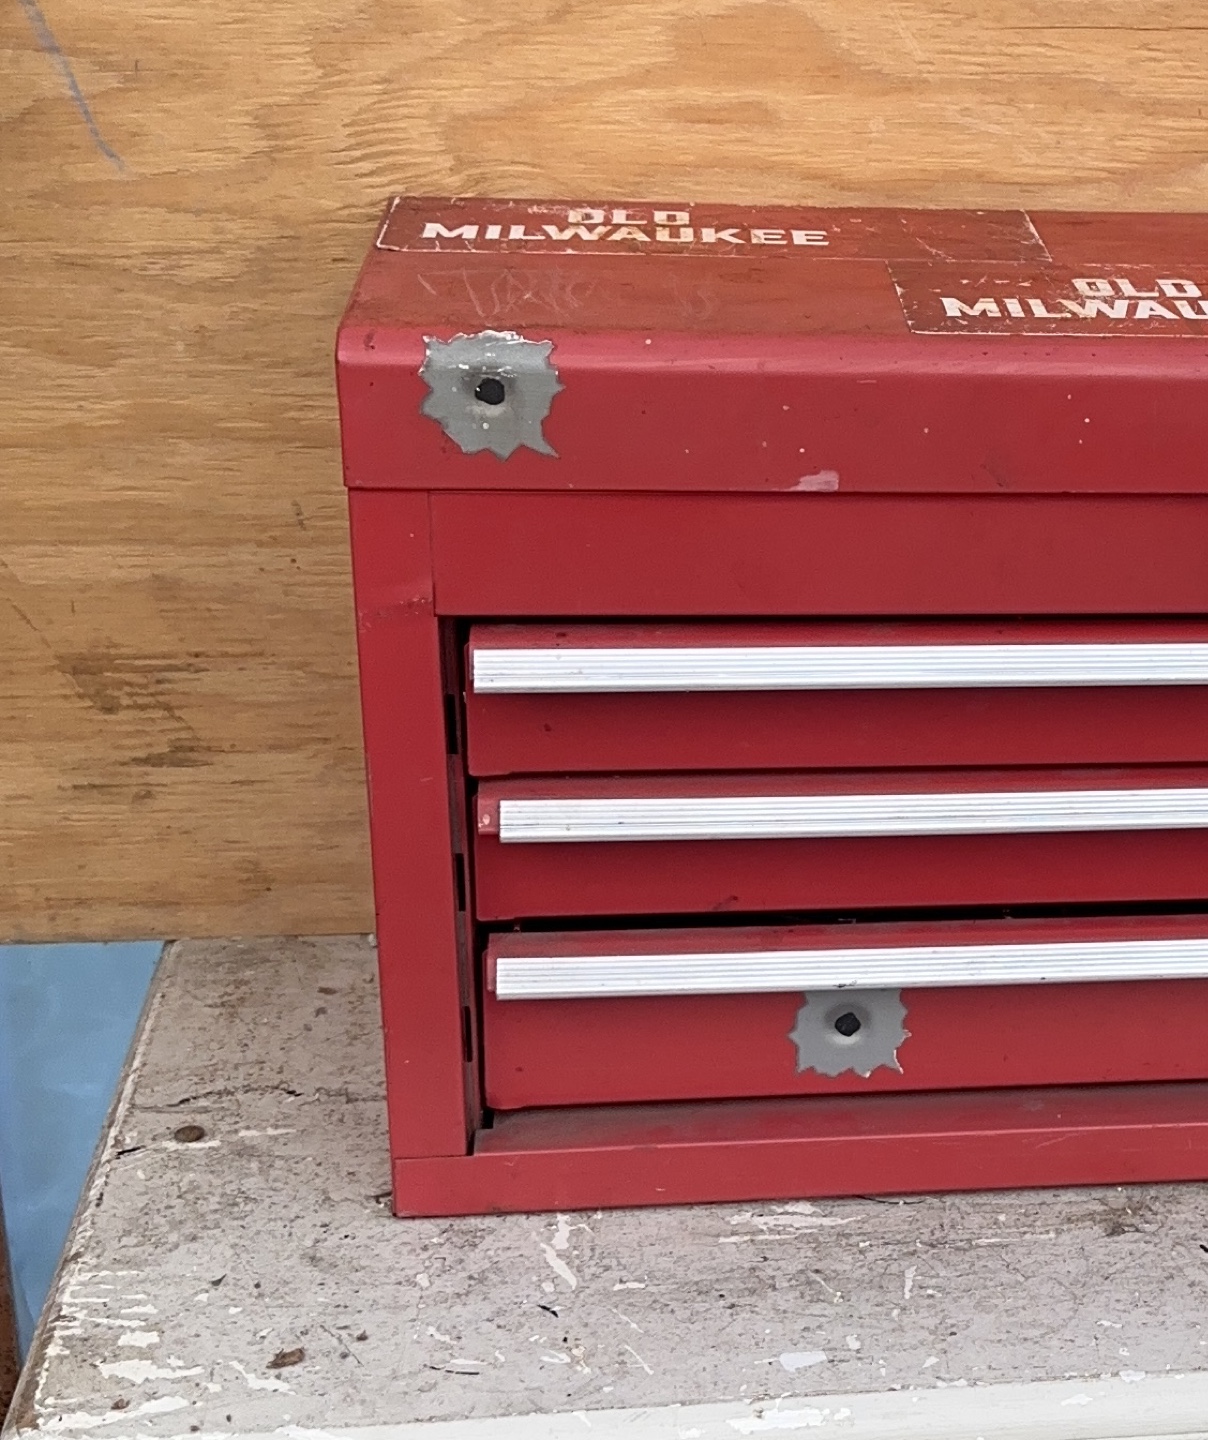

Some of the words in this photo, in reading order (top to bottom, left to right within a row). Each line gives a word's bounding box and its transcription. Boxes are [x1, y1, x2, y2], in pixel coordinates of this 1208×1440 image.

[568, 208, 690, 225] OLD
[422, 222, 830, 247] MILWAUKEE
[1071, 277, 1203, 298] OLD
